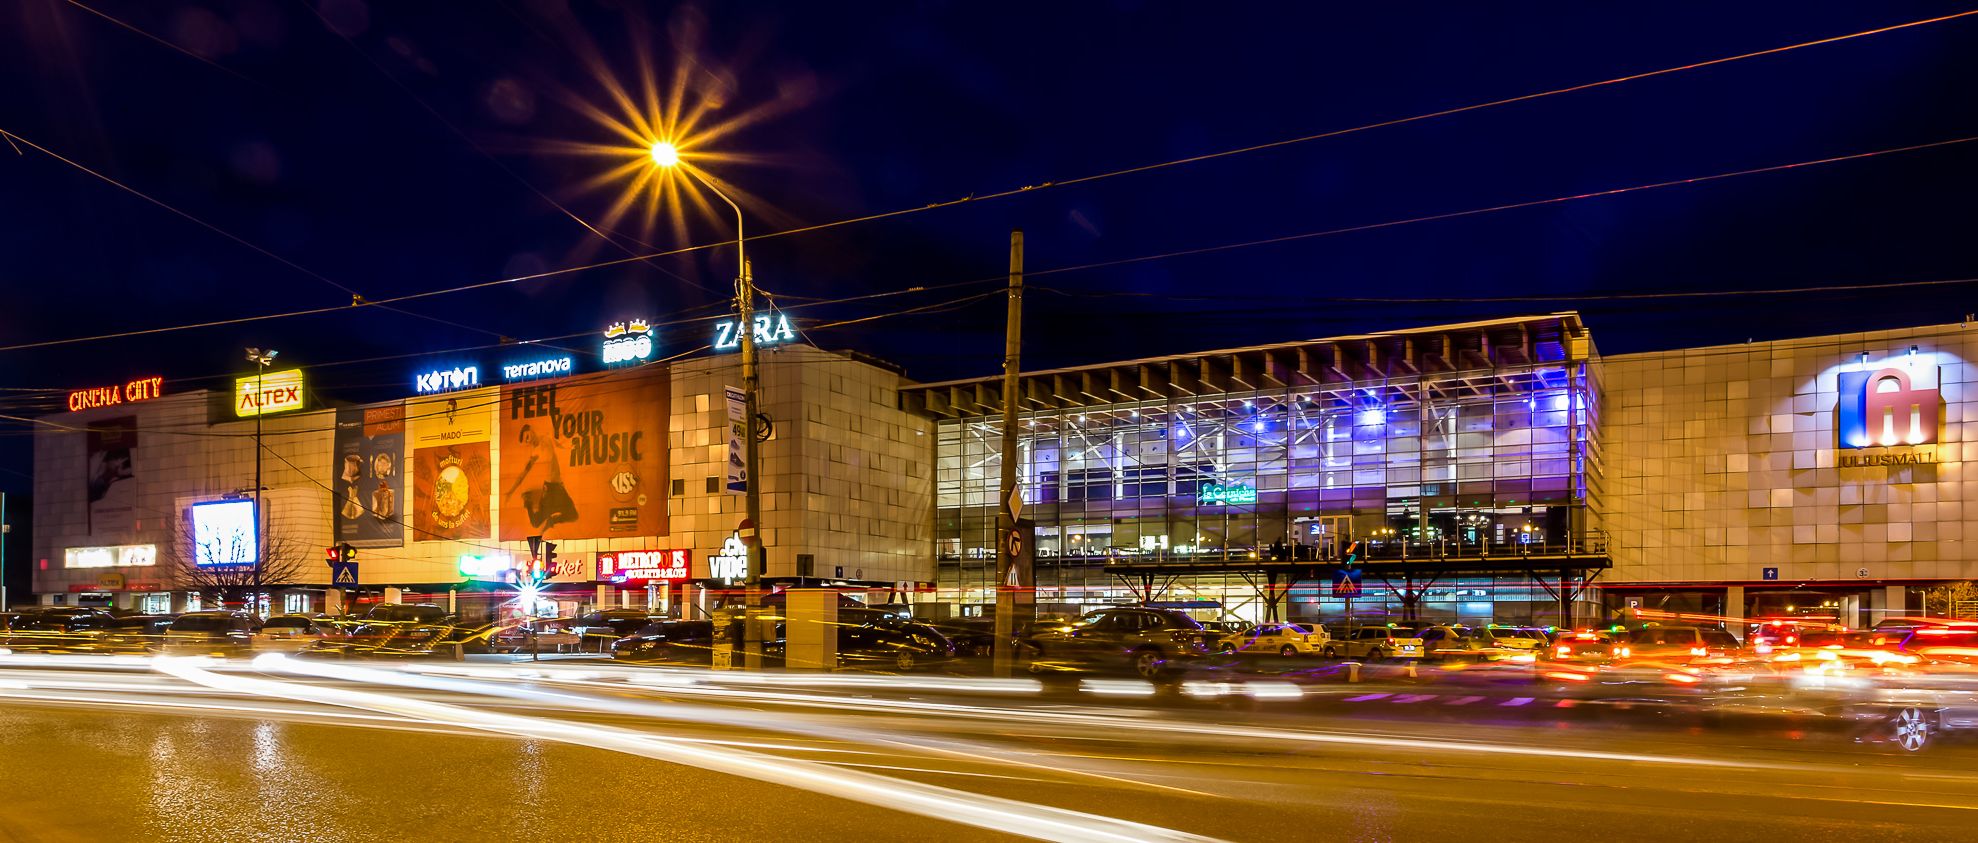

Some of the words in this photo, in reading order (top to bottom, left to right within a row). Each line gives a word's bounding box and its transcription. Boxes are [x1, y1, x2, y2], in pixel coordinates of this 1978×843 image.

[715, 315, 794, 348] ZARA
[504, 358, 570, 378] terranova
[69, 385, 121, 412] CINEMA
[126, 377, 161, 401] CITY
[241, 386, 298, 408] ALTEX
[511, 383, 560, 420] FEEL
[440, 430, 462, 440] MADO
[551, 410, 604, 439] YOUR
[569, 431, 643, 467] MUSIC
[1631, 601, 1638, 609] P
